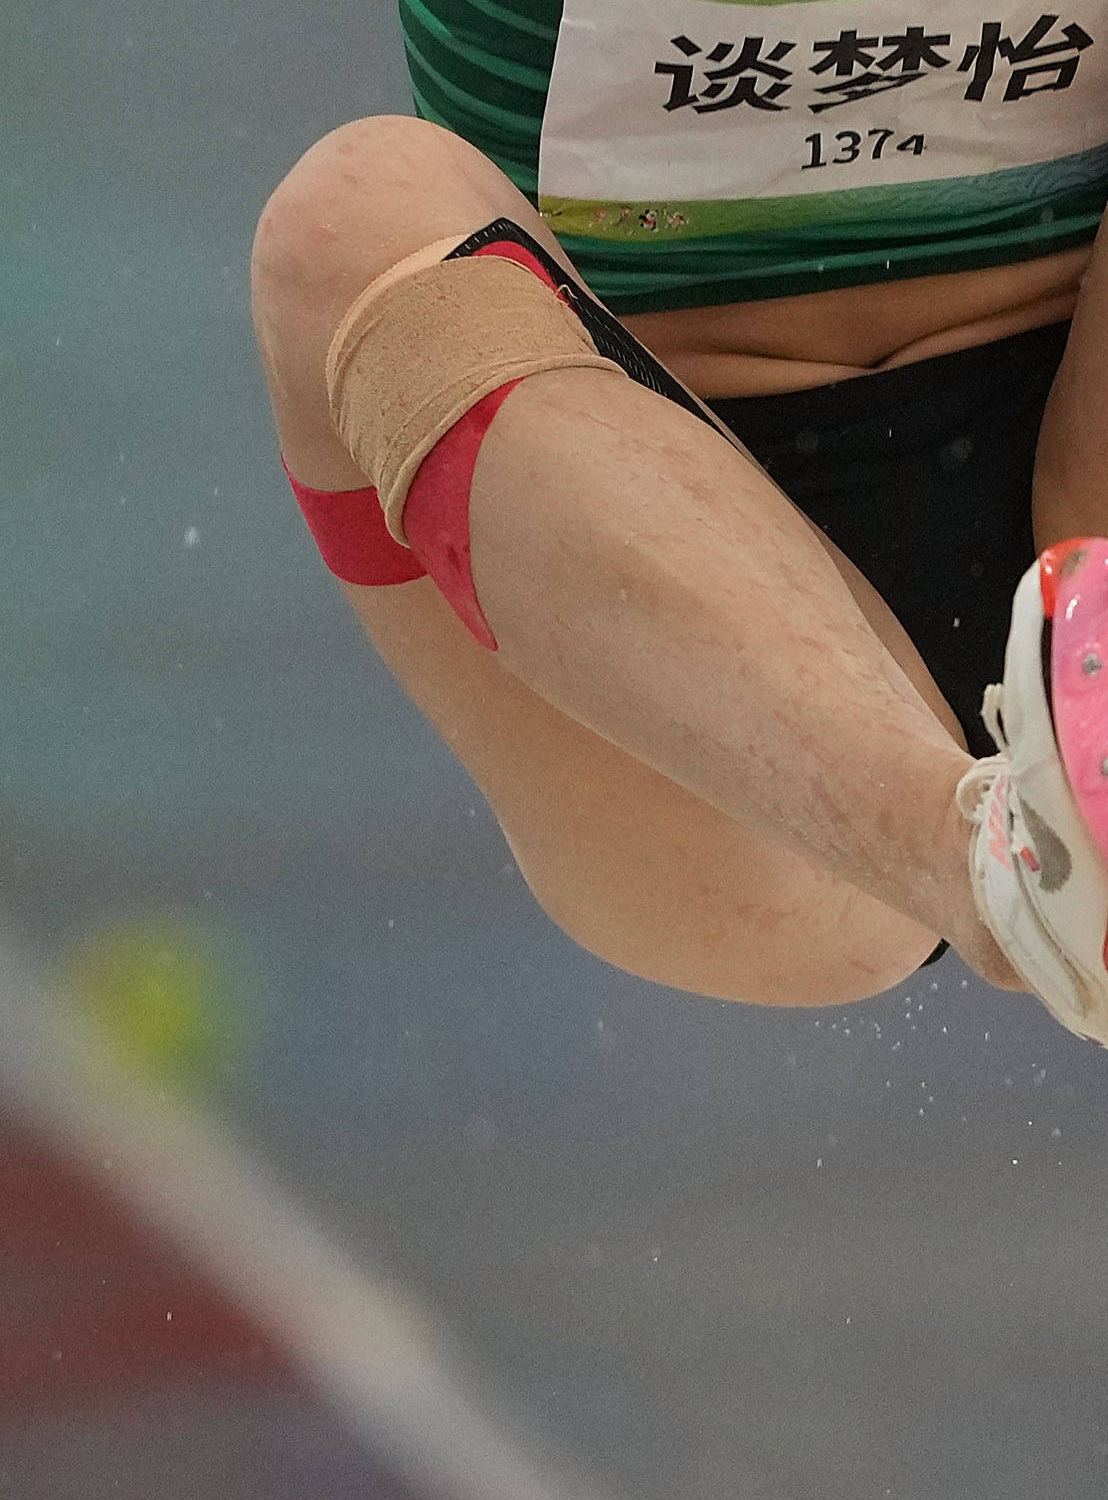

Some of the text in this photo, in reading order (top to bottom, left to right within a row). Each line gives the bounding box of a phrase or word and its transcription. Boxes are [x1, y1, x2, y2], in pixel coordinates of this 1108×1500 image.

[654, 13, 1095, 114] 谈梦怡
[801, 128, 928, 170] 1374
